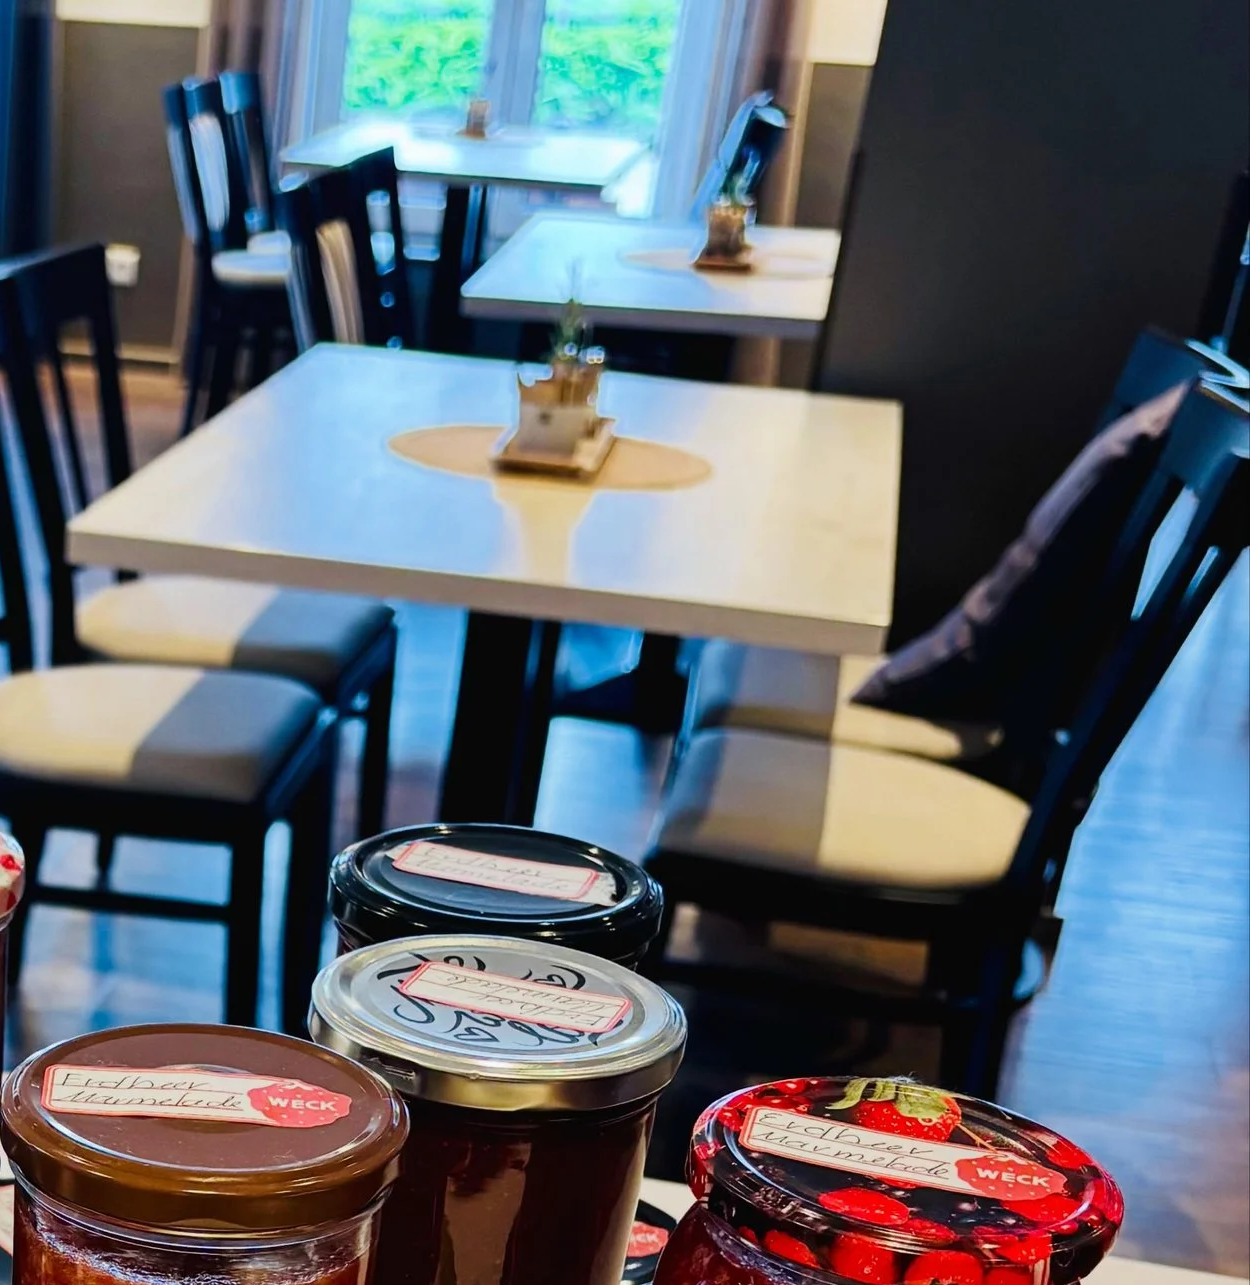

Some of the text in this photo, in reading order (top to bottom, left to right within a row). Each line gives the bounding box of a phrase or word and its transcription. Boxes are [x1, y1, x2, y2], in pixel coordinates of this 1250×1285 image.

[62, 1073, 206, 1090] Erdbeer
[56, 1090, 244, 1109] Marmelade
[268, 1097, 338, 1112] WECK
[759, 1112, 933, 1157] Erdbeer
[976, 1167, 1051, 1187] WECK
